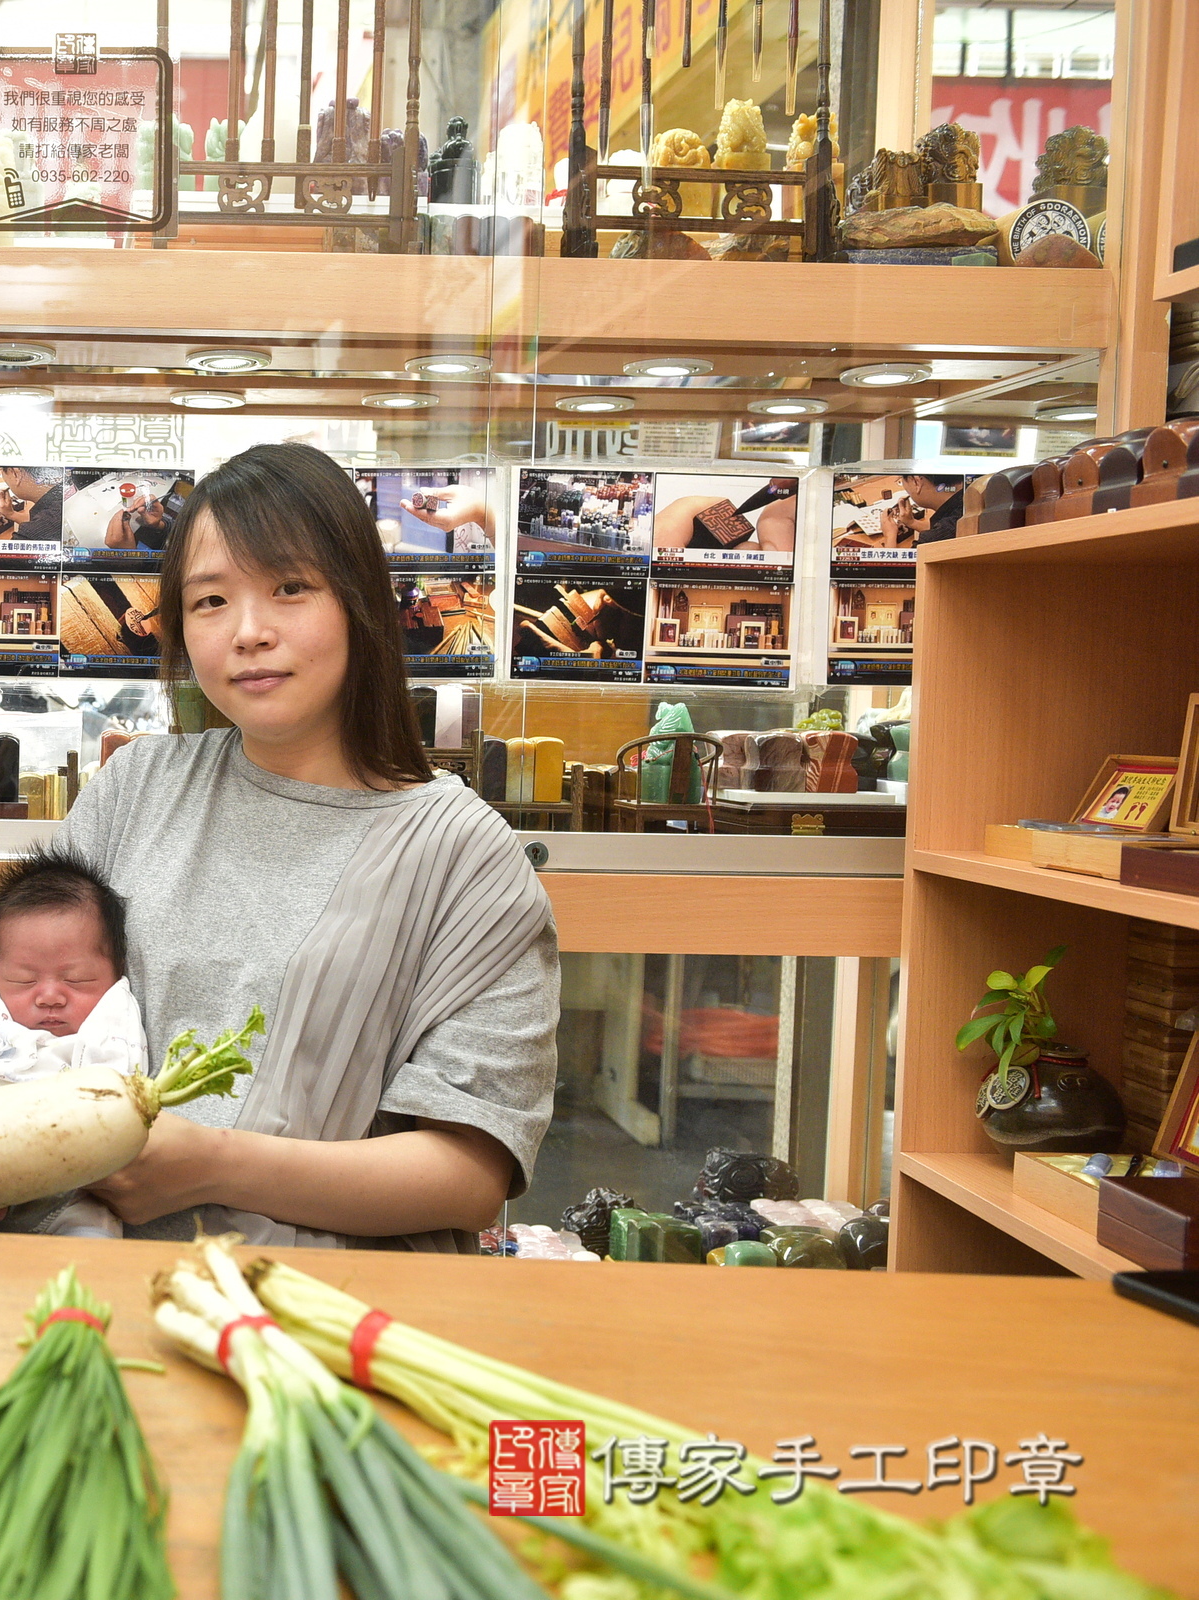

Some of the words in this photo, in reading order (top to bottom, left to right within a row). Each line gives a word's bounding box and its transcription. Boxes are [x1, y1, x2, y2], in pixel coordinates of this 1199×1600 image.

[3, 90, 146, 107] 我們很重視您的感受
[10, 117, 138, 133] 如有服務不周之處
[18, 143, 130, 159] 請打給傳家老闆
[31, 169, 130, 183] 0935-602-220
[1013, 217, 1028, 240] BIRTH
[1026, 208, 1037, 217] OF
[1047, 202, 1088, 244] DORAEMON
[860, 551, 899, 559] 生辰八字欠缺
